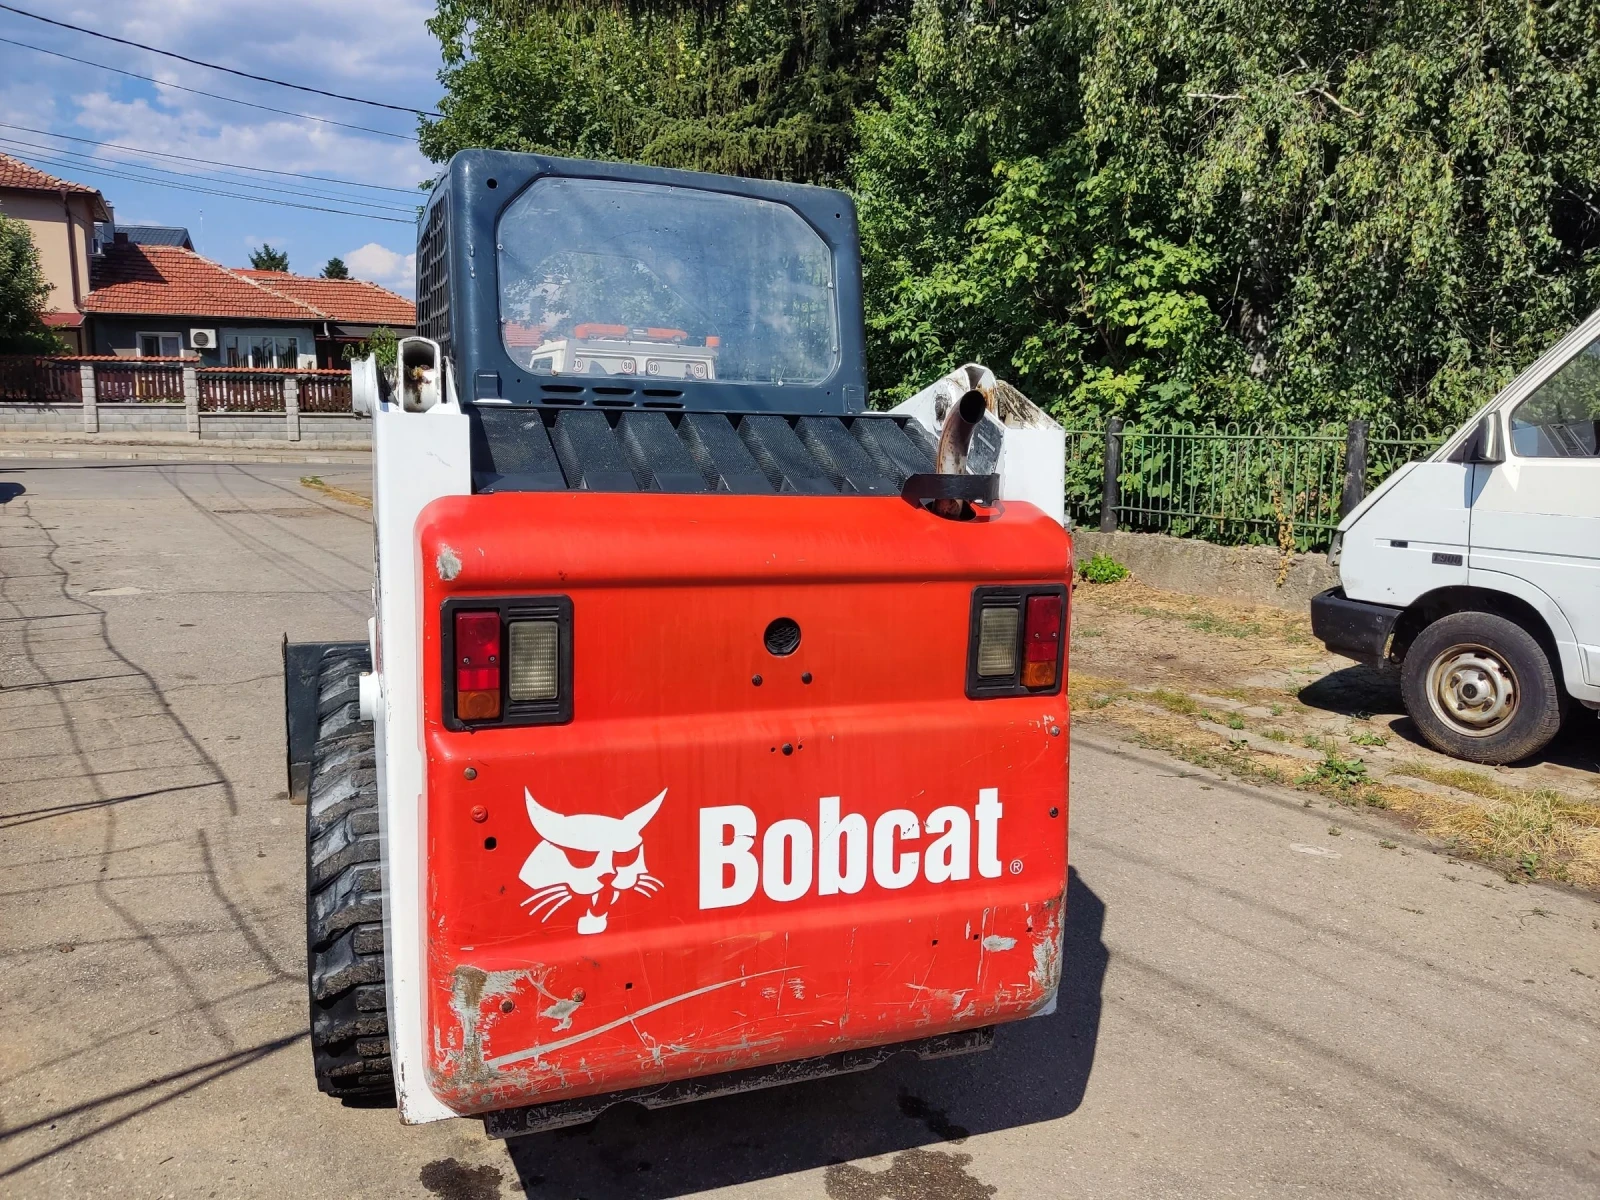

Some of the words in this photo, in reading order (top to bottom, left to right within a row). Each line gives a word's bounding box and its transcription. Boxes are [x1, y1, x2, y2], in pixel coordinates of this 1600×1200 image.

[623, 361, 632, 370] 80
[649, 363, 658, 372] 80
[699, 787, 1003, 910] Bobcat
